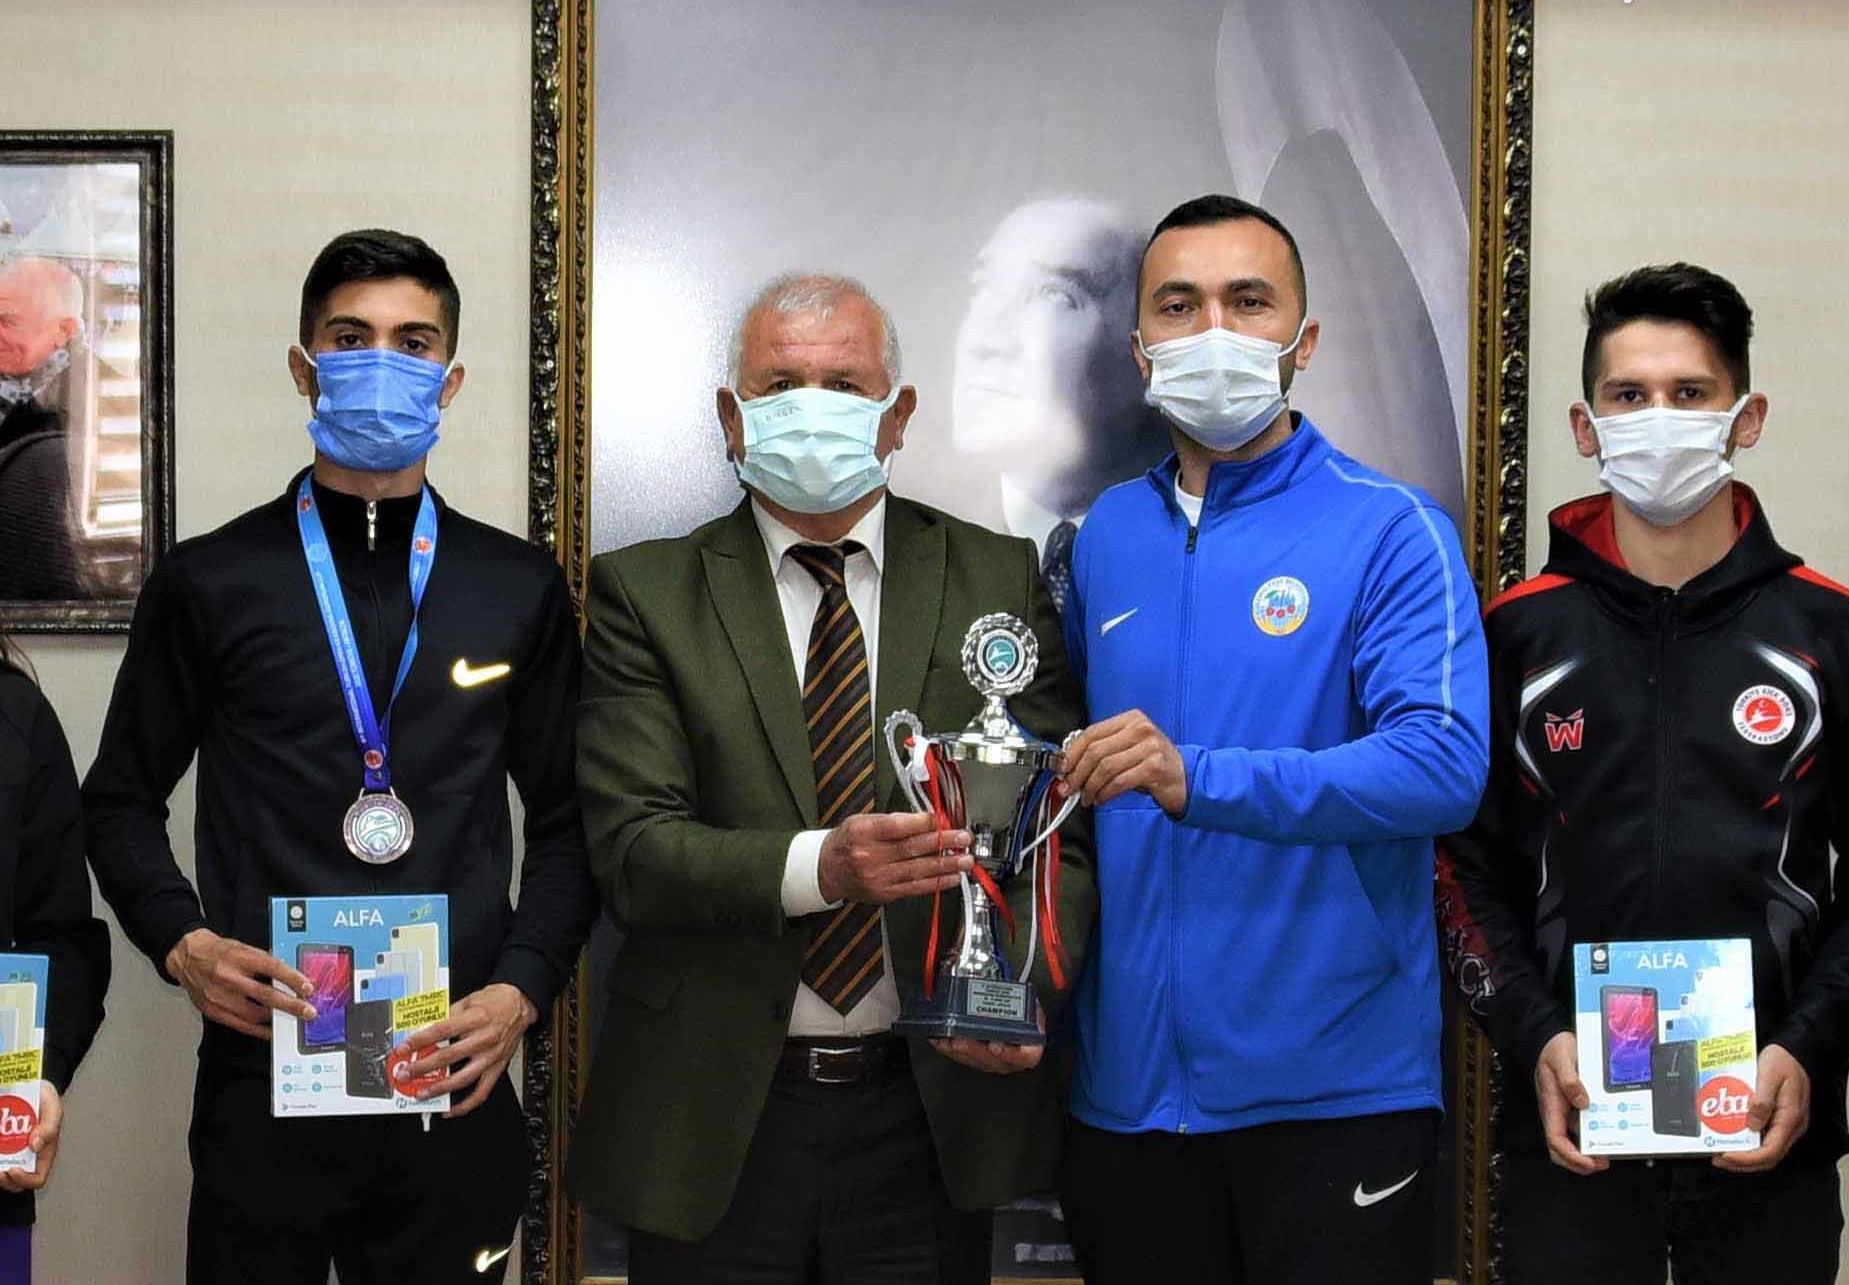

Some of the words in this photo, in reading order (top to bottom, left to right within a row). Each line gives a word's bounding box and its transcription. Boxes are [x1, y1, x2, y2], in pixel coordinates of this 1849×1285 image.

[333, 908, 385, 927] ALFA
[1637, 951, 1689, 970] ALFA
[1701, 1087, 1751, 1115] eba
